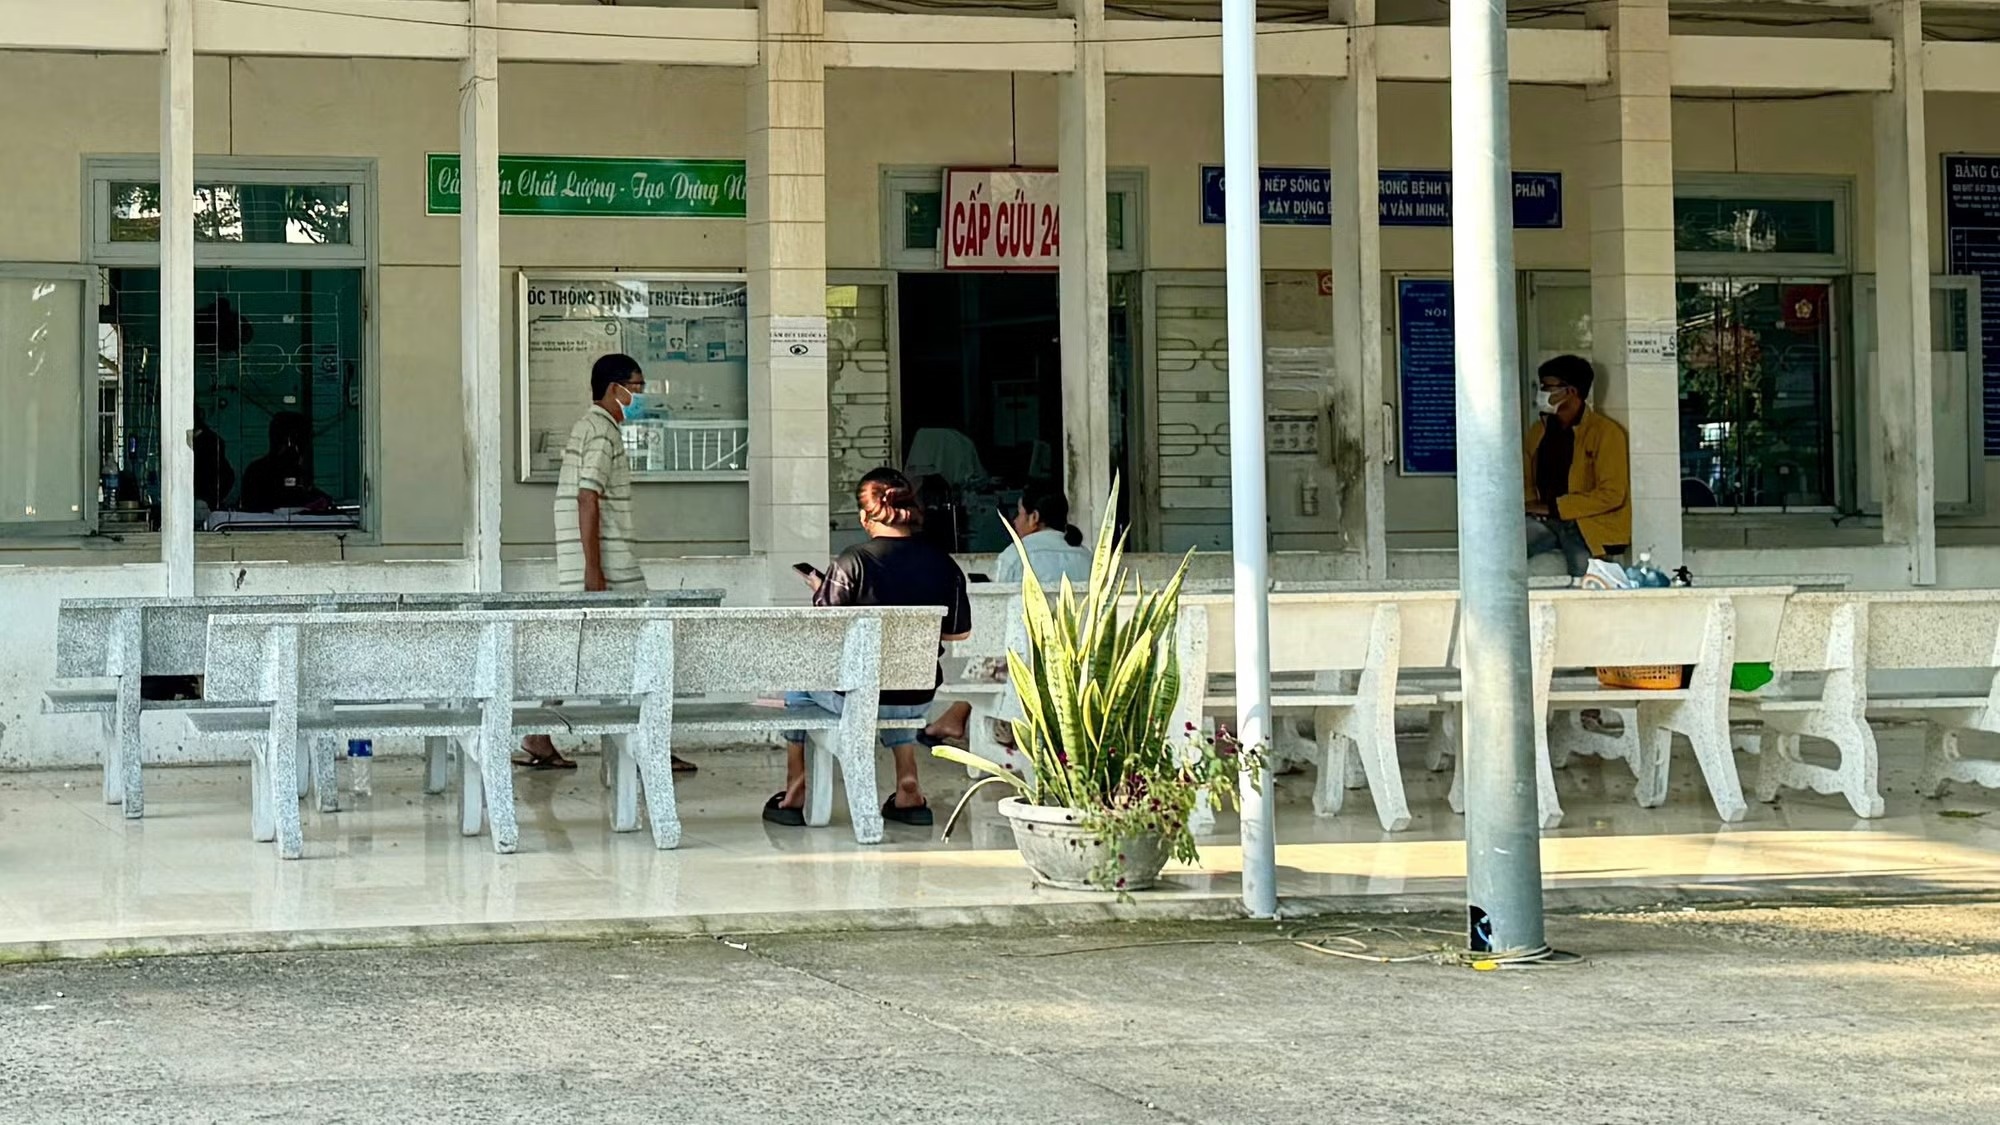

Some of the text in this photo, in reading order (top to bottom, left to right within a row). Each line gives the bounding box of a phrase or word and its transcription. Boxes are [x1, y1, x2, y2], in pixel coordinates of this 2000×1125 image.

[438, 167, 460, 194] Cả
[518, 169, 557, 196] Chất
[560, 171, 617, 204] Lượng
[631, 172, 664, 206] Tạo
[670, 172, 719, 206] Dựng
[1290, 175, 1320, 193] SỐNG
[1378, 179, 1408, 195] RONG
[1411, 178, 1442, 199] BỆNH
[953, 182, 1060, 257] CẤP CỨU 24
[550, 286, 596, 305] THÔNG
